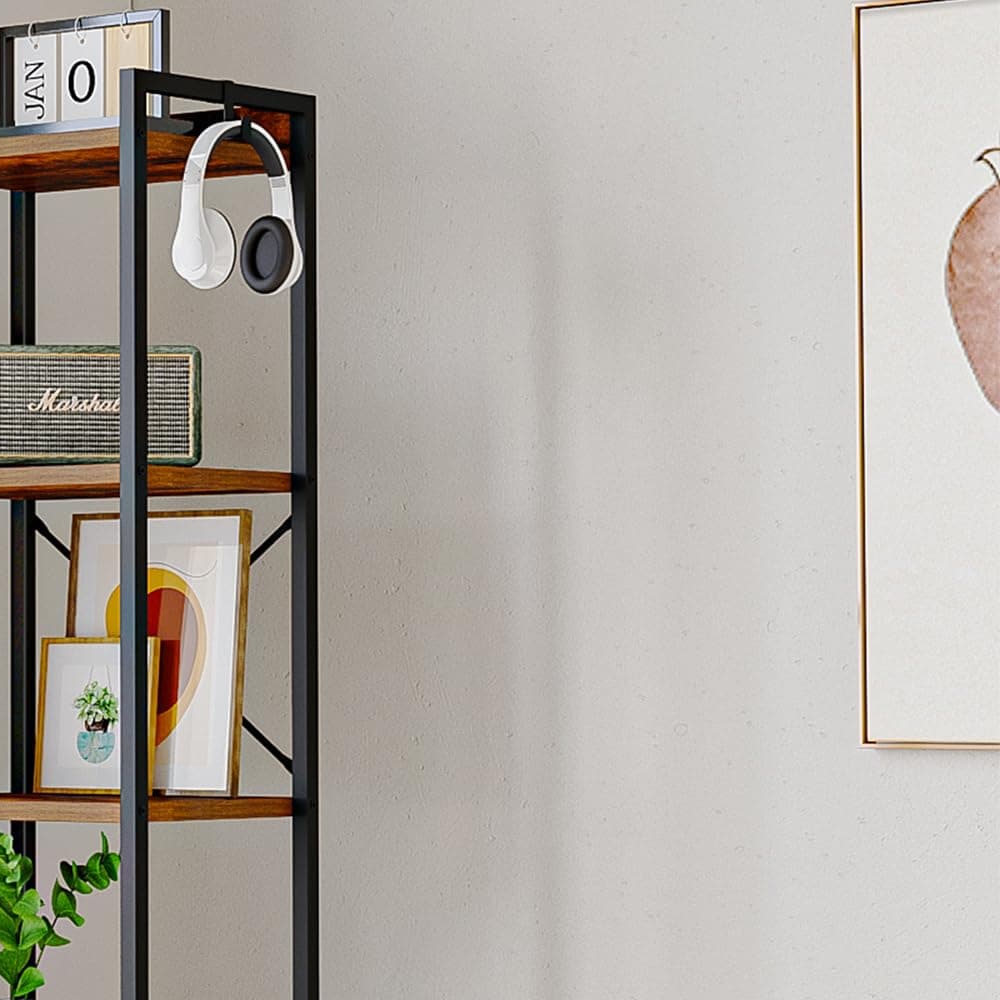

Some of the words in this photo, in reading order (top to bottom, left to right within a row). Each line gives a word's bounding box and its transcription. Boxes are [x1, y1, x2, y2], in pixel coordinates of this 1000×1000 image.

[24, 61, 45, 119] JAN
[68, 60, 96, 104] 0
[27, 387, 120, 412] Marshal
